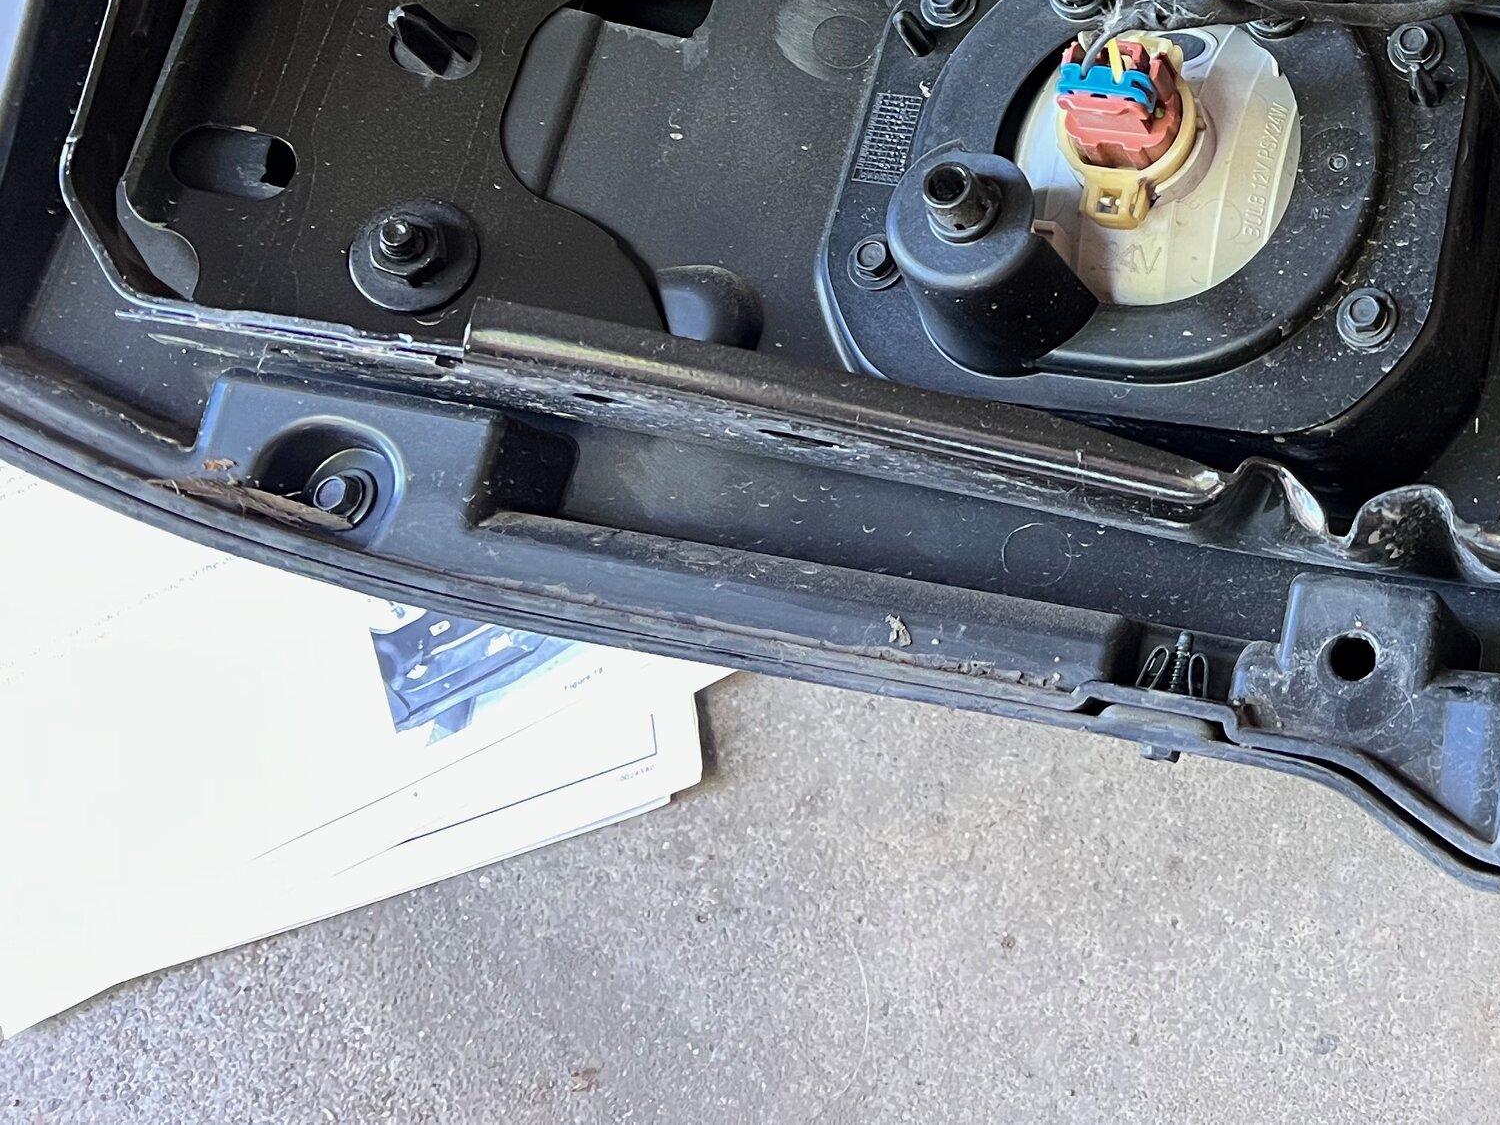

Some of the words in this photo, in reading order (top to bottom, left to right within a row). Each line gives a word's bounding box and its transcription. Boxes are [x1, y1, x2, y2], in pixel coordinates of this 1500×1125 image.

[1256, 101, 1290, 161] PSX24W
[1251, 160, 1273, 189] 12V
[1242, 194, 1267, 237] BULB
